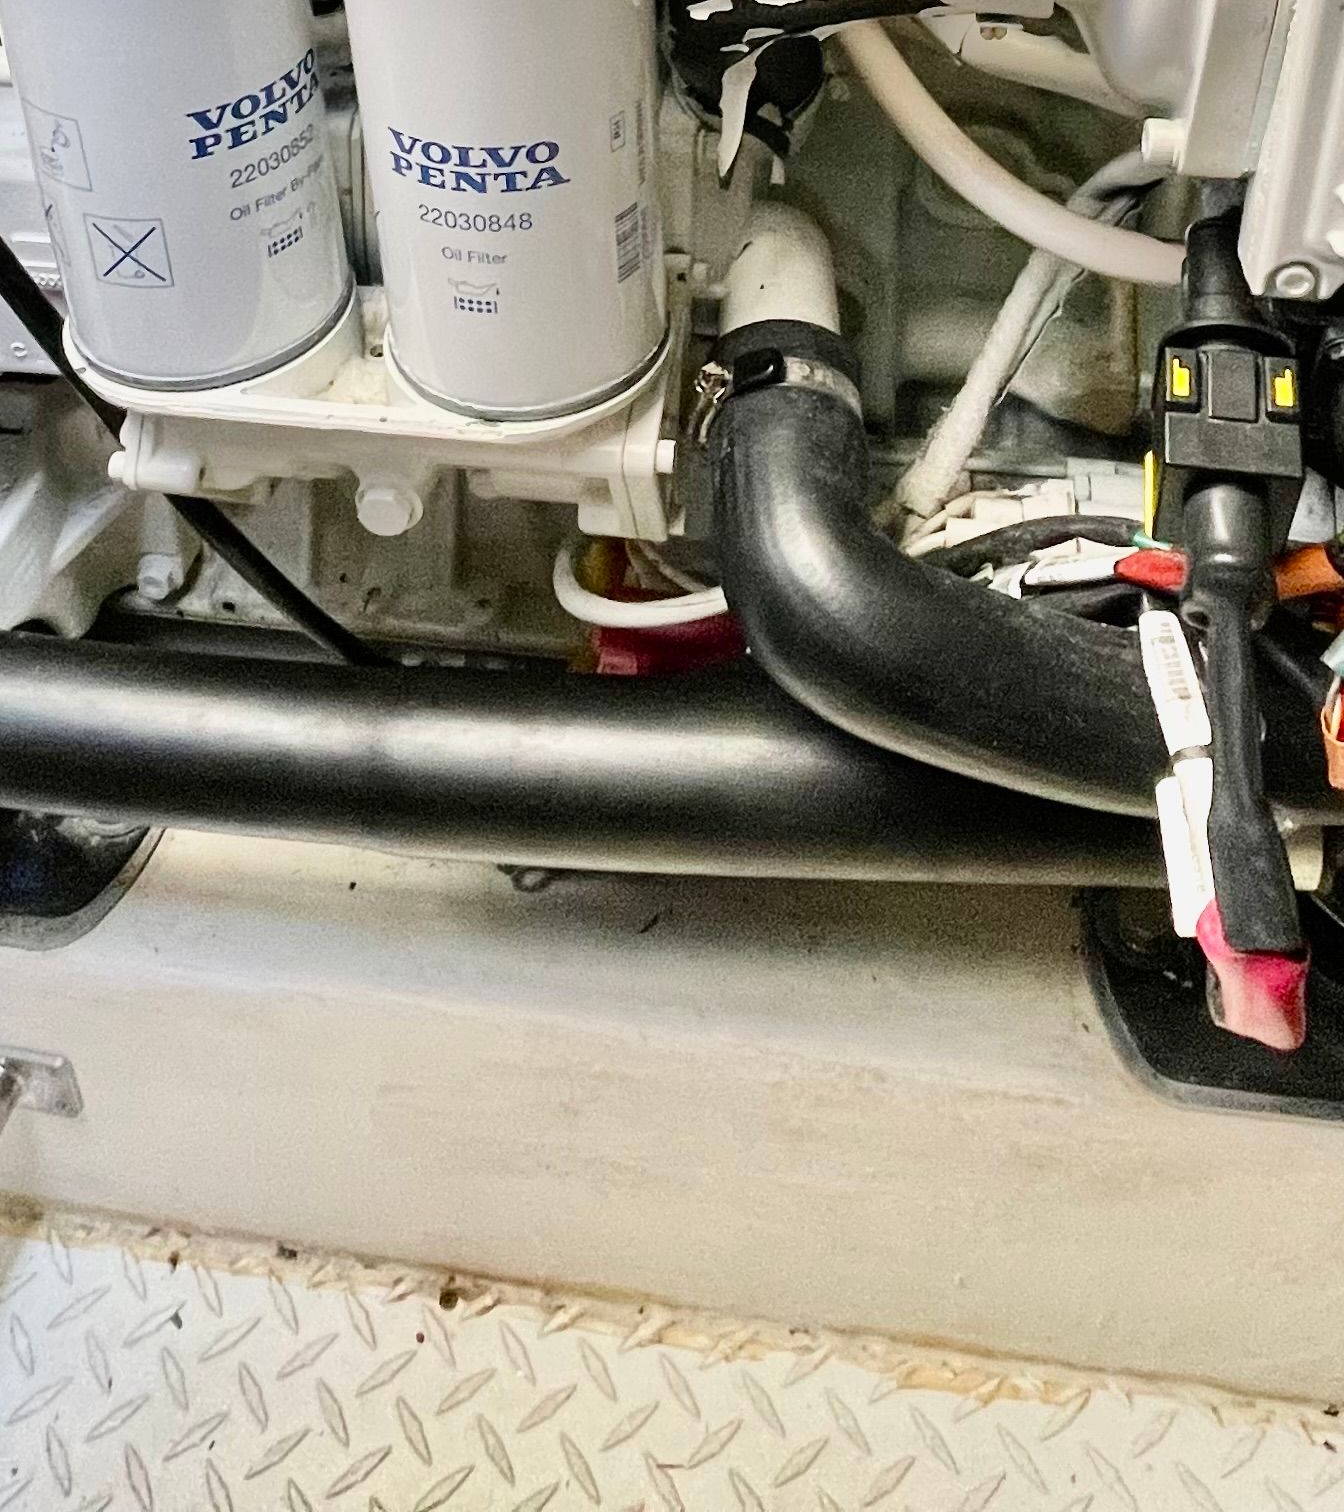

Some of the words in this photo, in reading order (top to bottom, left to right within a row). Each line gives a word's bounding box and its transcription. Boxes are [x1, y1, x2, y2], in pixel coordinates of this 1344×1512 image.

[185, 48, 315, 131] VOLVO
[188, 71, 320, 160] PENTA
[230, 122, 314, 189] 22030852
[387, 126, 560, 169] VOLVO
[389, 150, 571, 194] PENTA
[230, 205, 251, 221] Oil
[256, 186, 287, 212] Filter
[418, 204, 533, 233] 22030848
[441, 246, 461, 261] Oil
[467, 250, 508, 264] Filter
